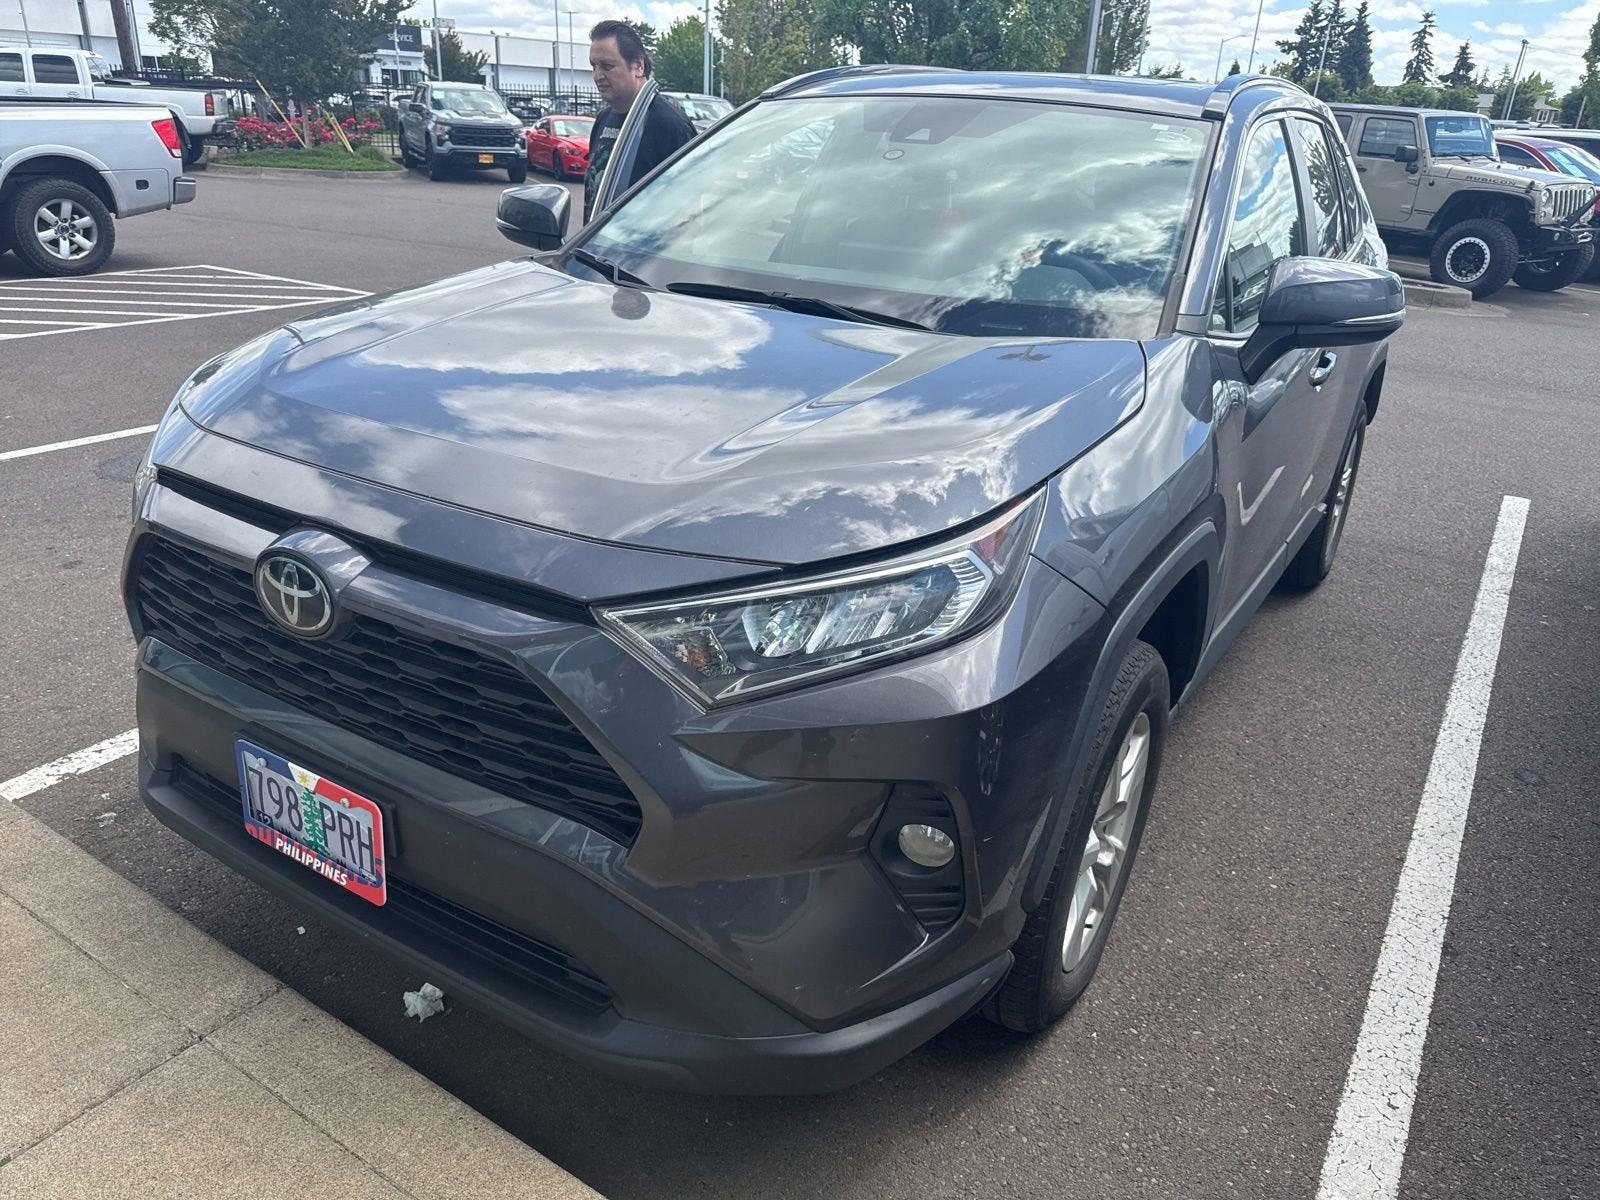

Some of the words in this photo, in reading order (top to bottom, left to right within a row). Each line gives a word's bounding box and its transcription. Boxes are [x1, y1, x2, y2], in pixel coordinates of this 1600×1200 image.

[1466, 175, 1517, 186] RUBICON
[247, 766, 303, 831] 798
[319, 801, 374, 874] PRH
[275, 837, 348, 886] PHILIPPINES
